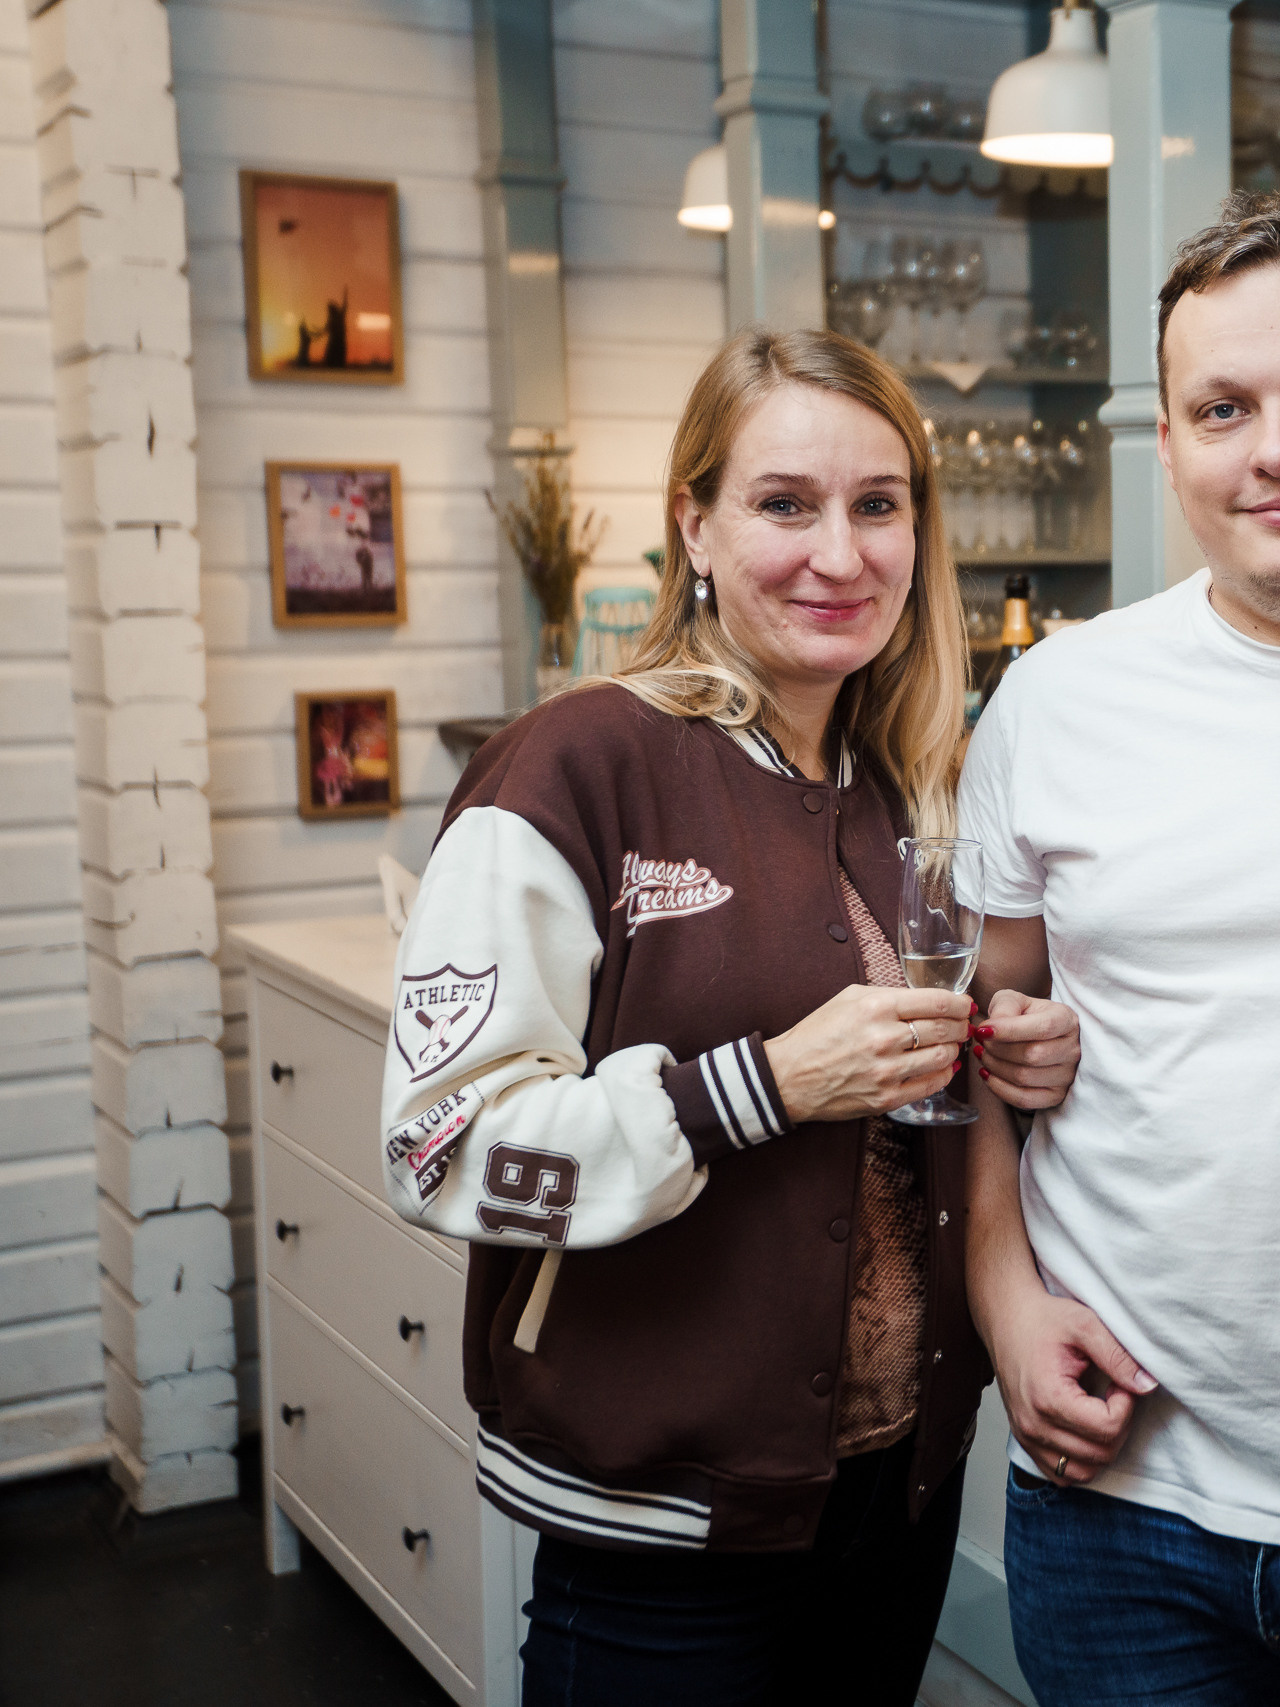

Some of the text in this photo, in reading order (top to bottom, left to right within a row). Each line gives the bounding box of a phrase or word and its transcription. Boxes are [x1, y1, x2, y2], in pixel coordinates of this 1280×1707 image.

[404, 984, 485, 1010] ATHLETIC
[386, 1129, 418, 1165] NEW
[415, 1089, 467, 1134] YORK
[476, 1141, 580, 1247] 19
